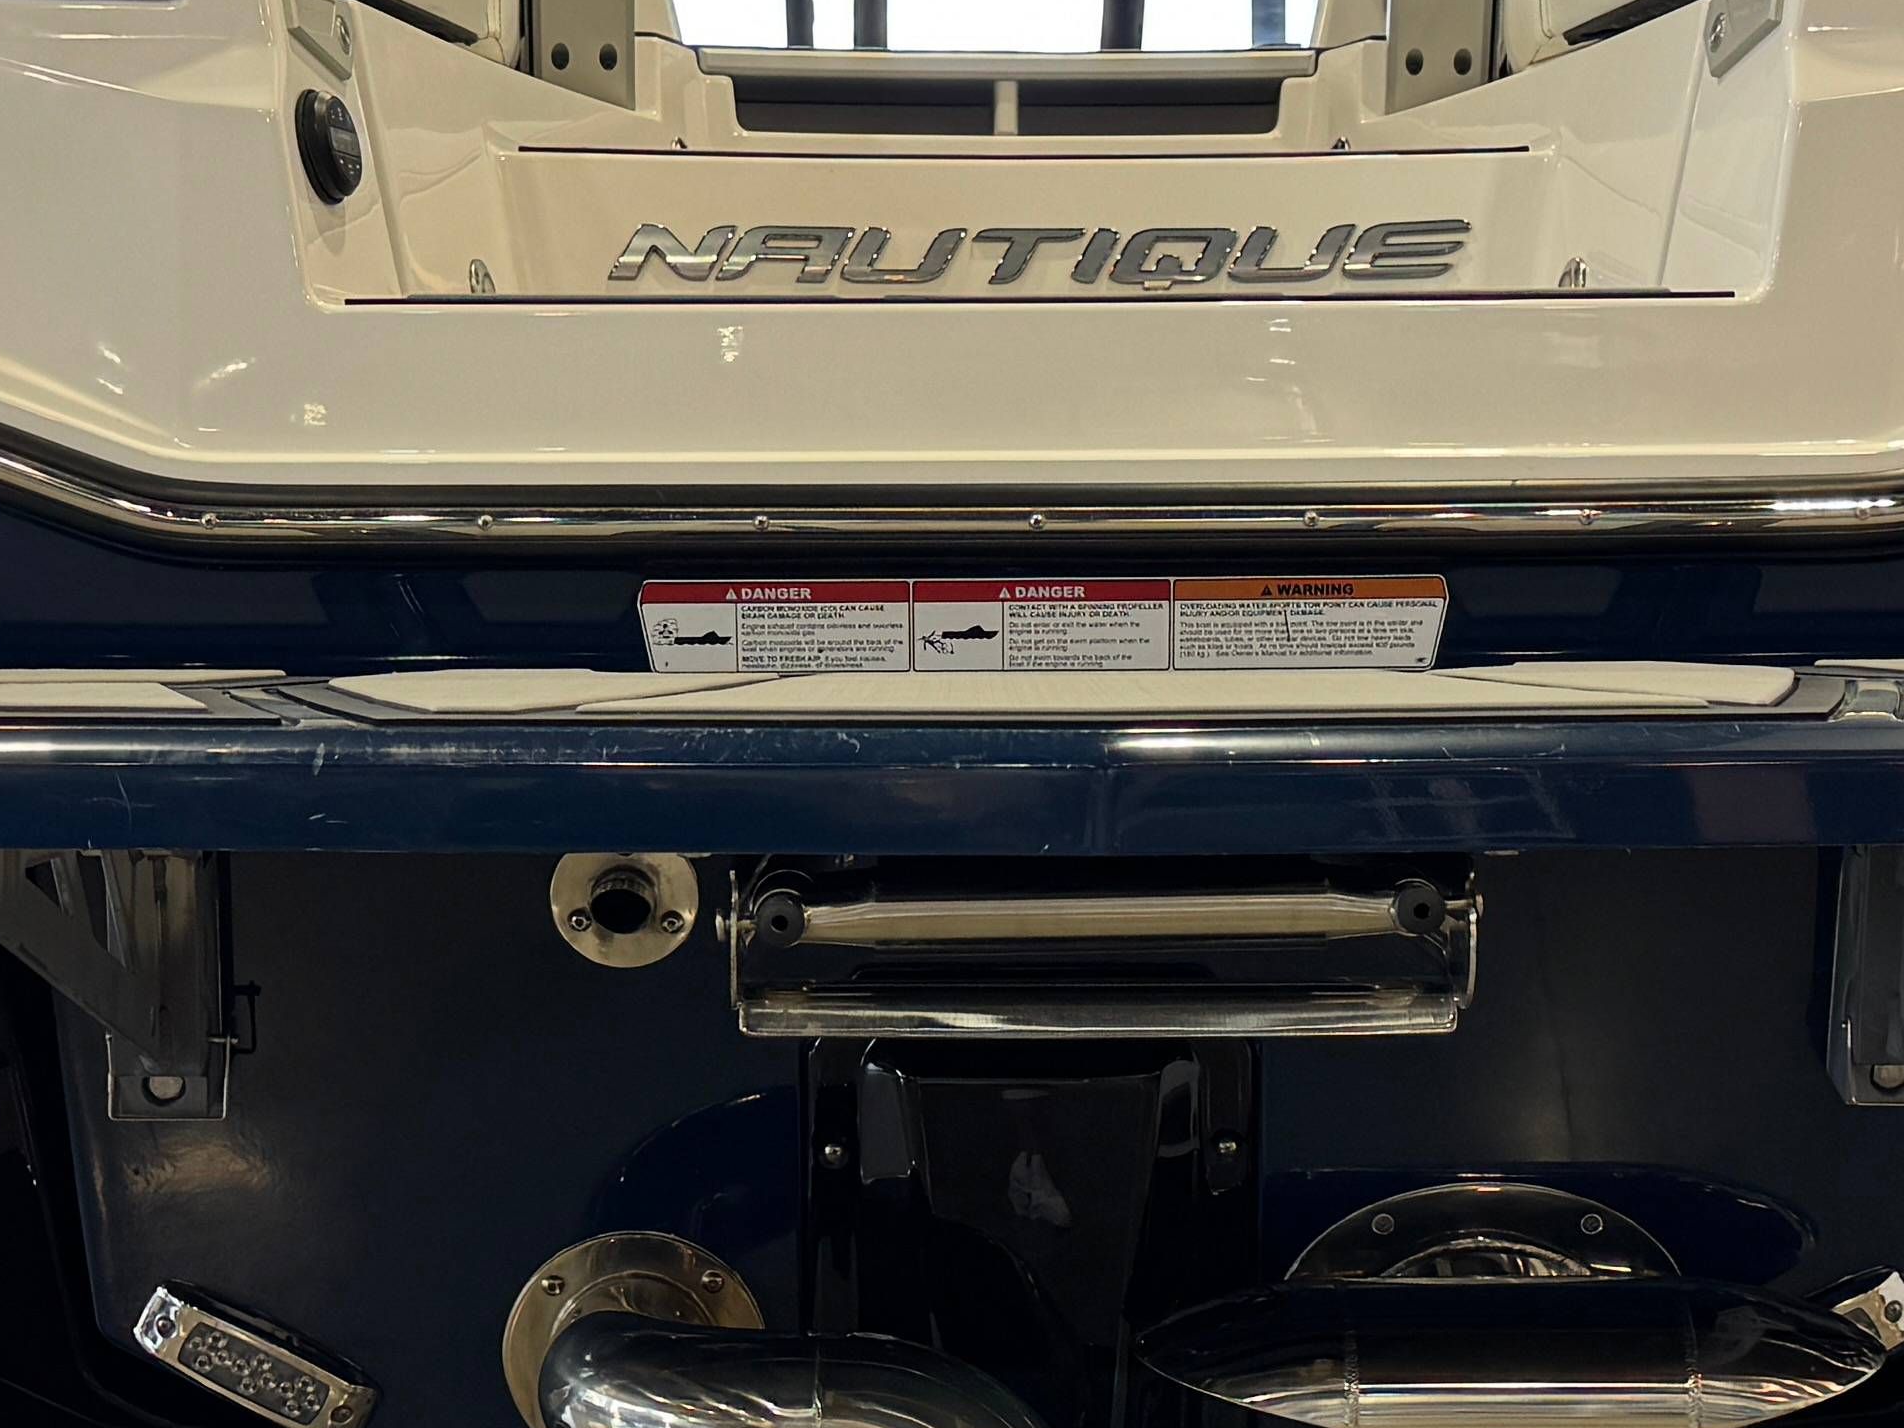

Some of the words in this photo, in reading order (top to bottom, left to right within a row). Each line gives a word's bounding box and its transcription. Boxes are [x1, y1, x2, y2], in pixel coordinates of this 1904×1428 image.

[606, 220, 1474, 290] NAUTIQUE
[741, 588, 812, 600] DANGER
[1015, 586, 1086, 598] DANGER
[1277, 583, 1354, 596] WARNING
